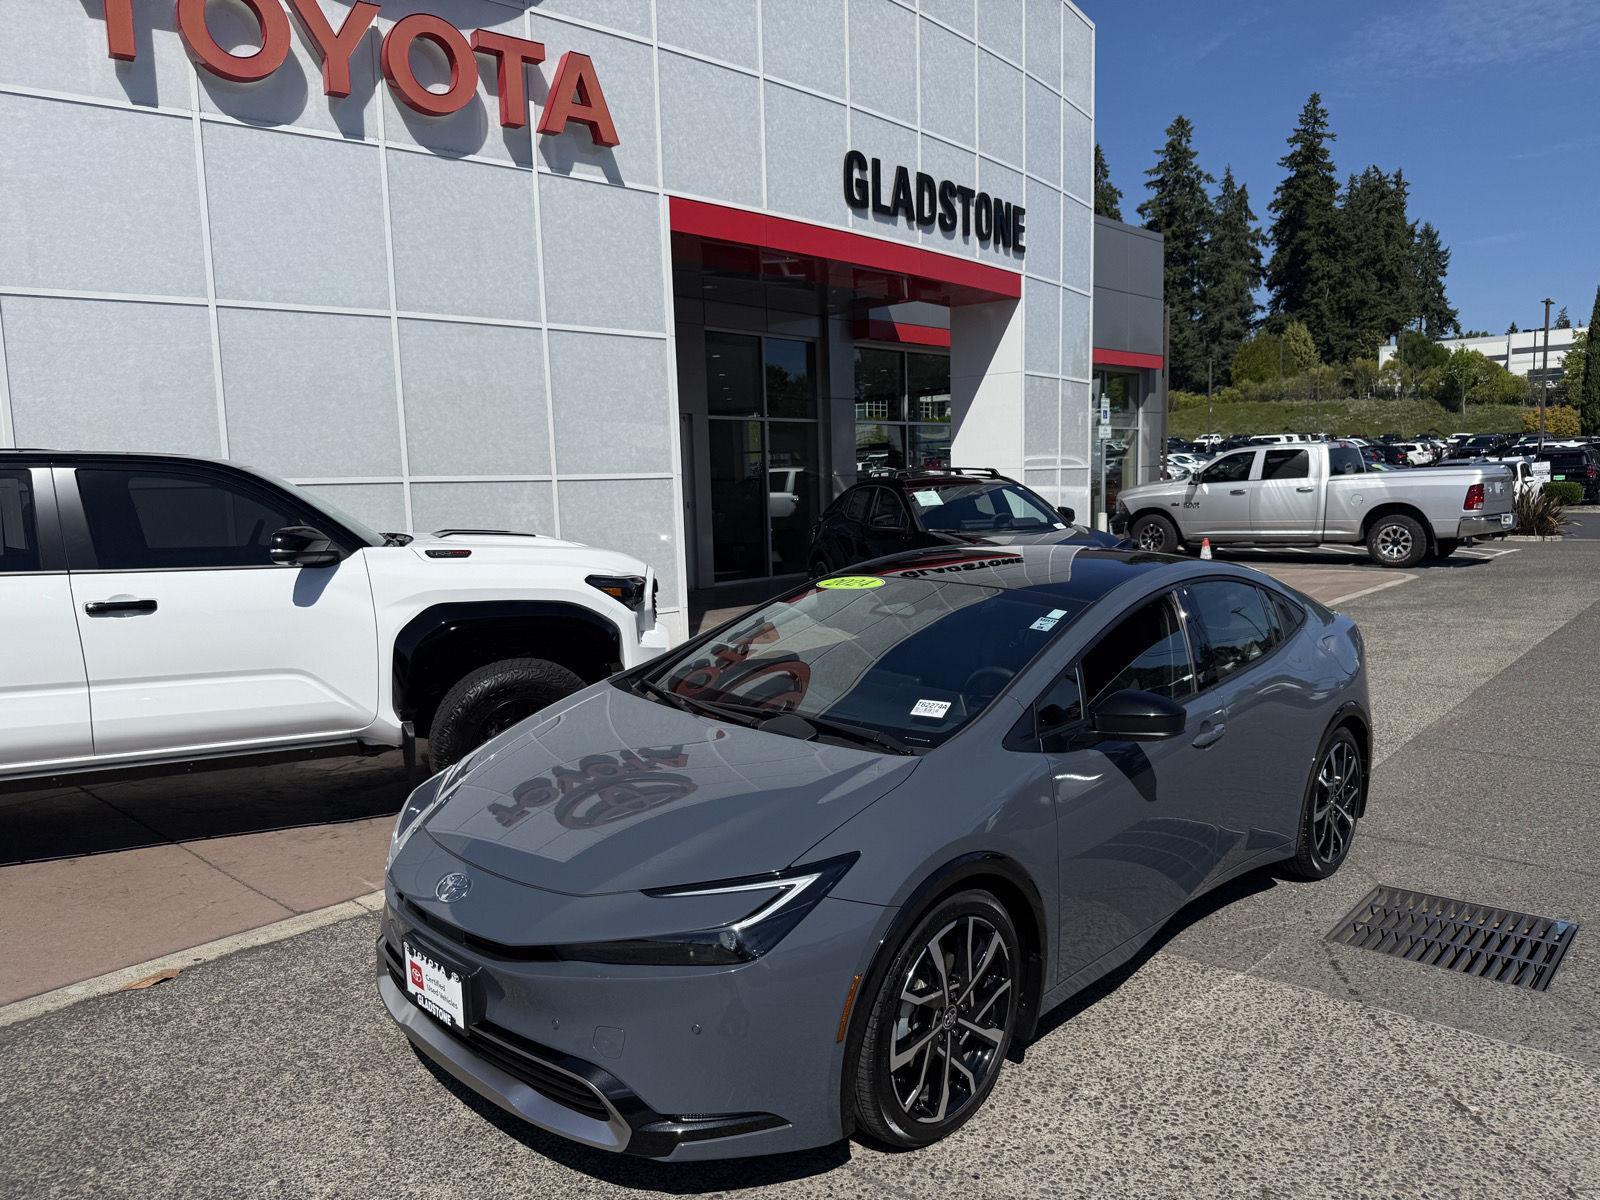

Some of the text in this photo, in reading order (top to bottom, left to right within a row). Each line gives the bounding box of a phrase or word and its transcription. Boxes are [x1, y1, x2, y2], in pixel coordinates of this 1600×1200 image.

[843, 149, 1026, 253] GLADSTONE
[412, 948, 445, 975] TOYOTA
[425, 974, 446, 992] Certified
[426, 985, 439, 997] Used
[417, 993, 453, 1025] GLADSTONE
